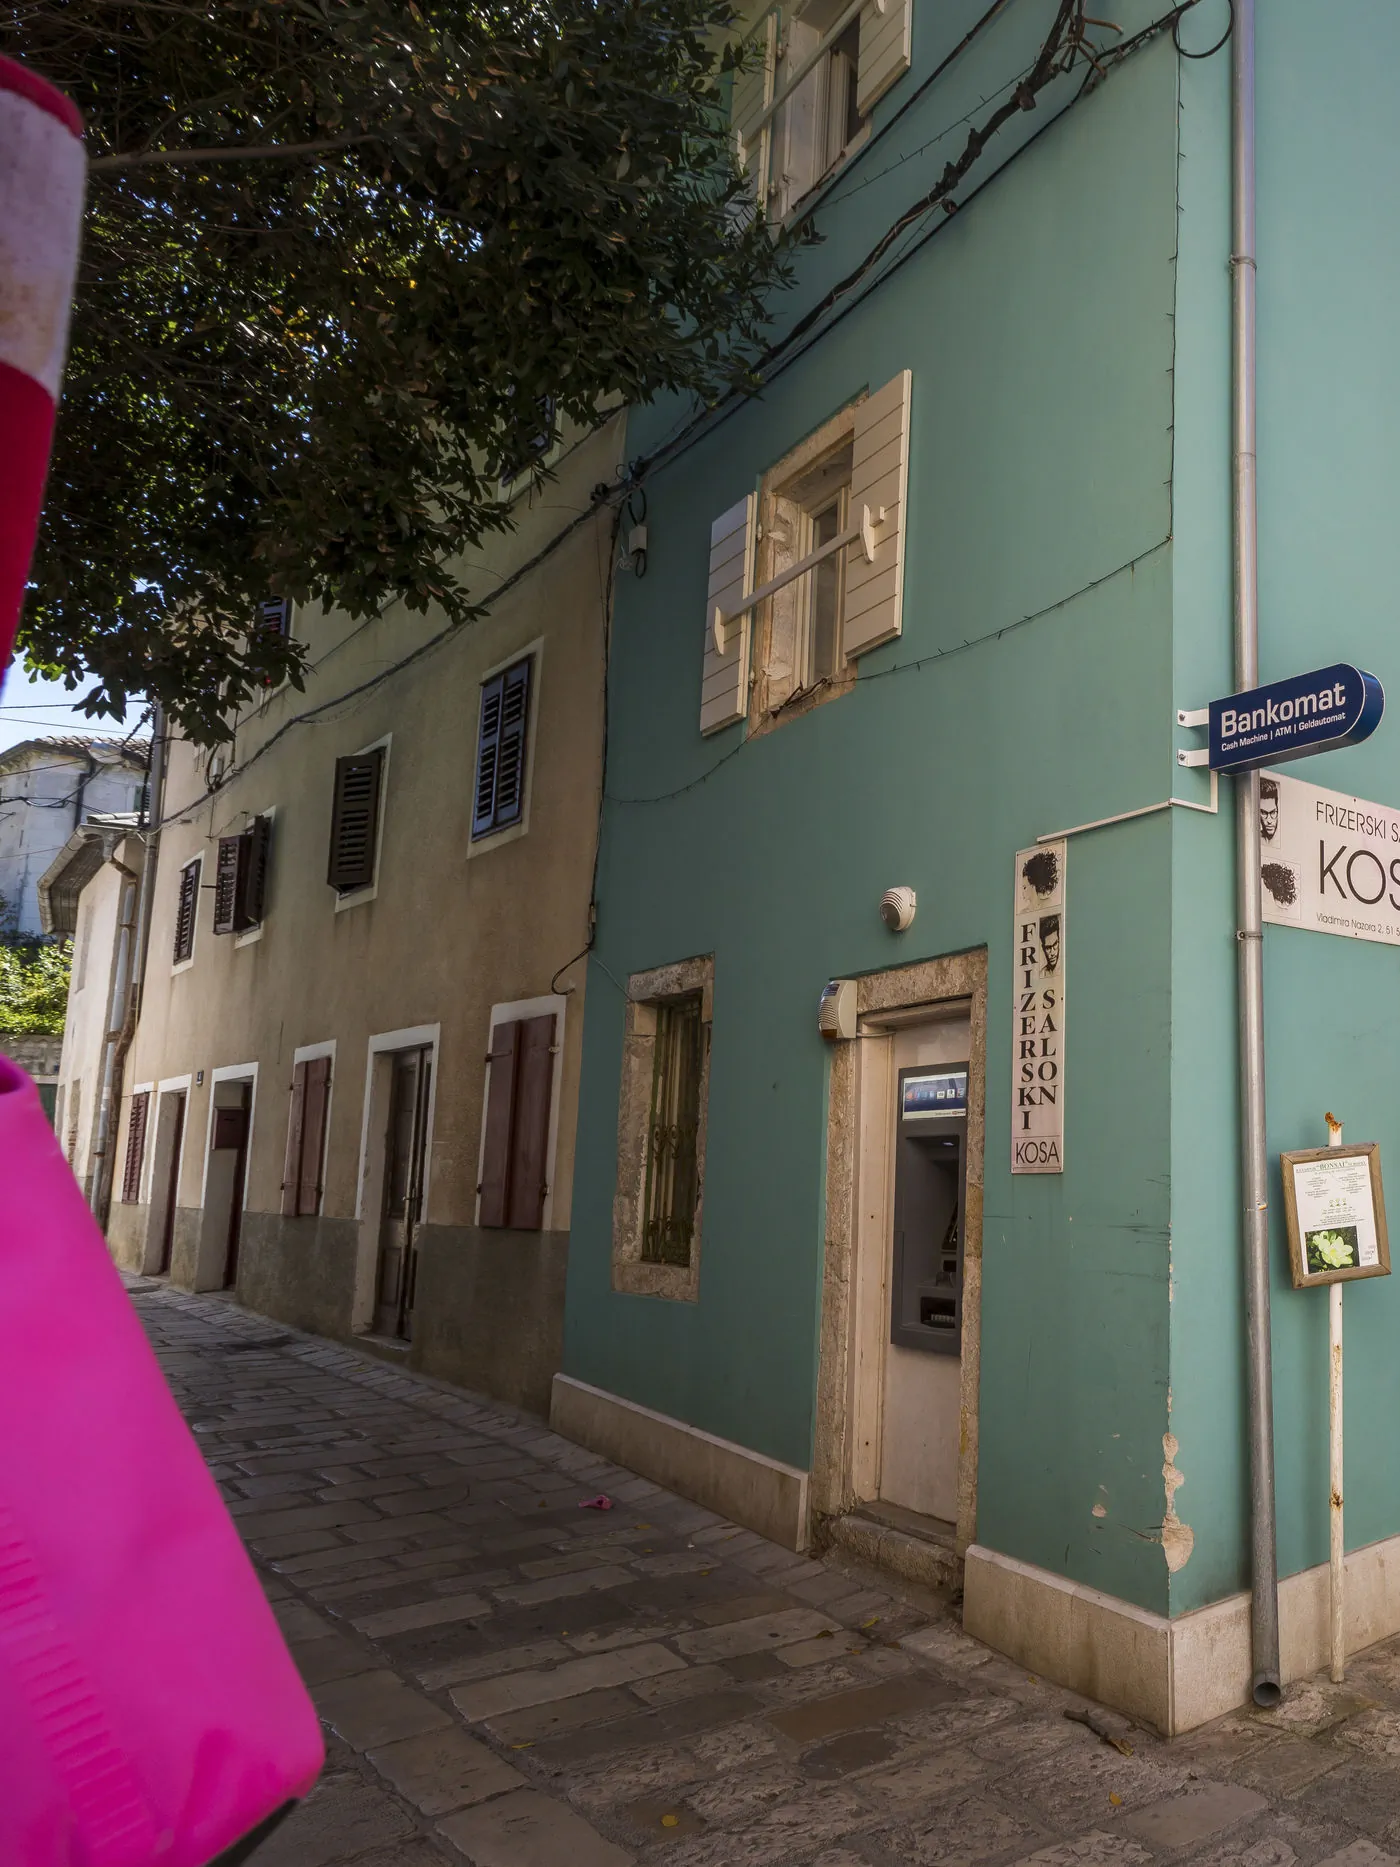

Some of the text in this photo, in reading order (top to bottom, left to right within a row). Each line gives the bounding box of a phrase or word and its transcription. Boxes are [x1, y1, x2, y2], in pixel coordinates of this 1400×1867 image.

[1221, 682, 1346, 738] Bankomat
[1221, 712, 1346, 752] Cash Machine ATM Geldautomat
[1316, 801, 1386, 839] FRIZERSKI
[1316, 912, 1350, 928] Vladimira
[1351, 919, 1376, 932] Nazora
[1386, 926, 1394, 935] 51
[1017, 922, 1038, 1130] FRIZERSKI
[1038, 988, 1058, 1106] SALON
[1015, 1141, 1060, 1165] KOSA
